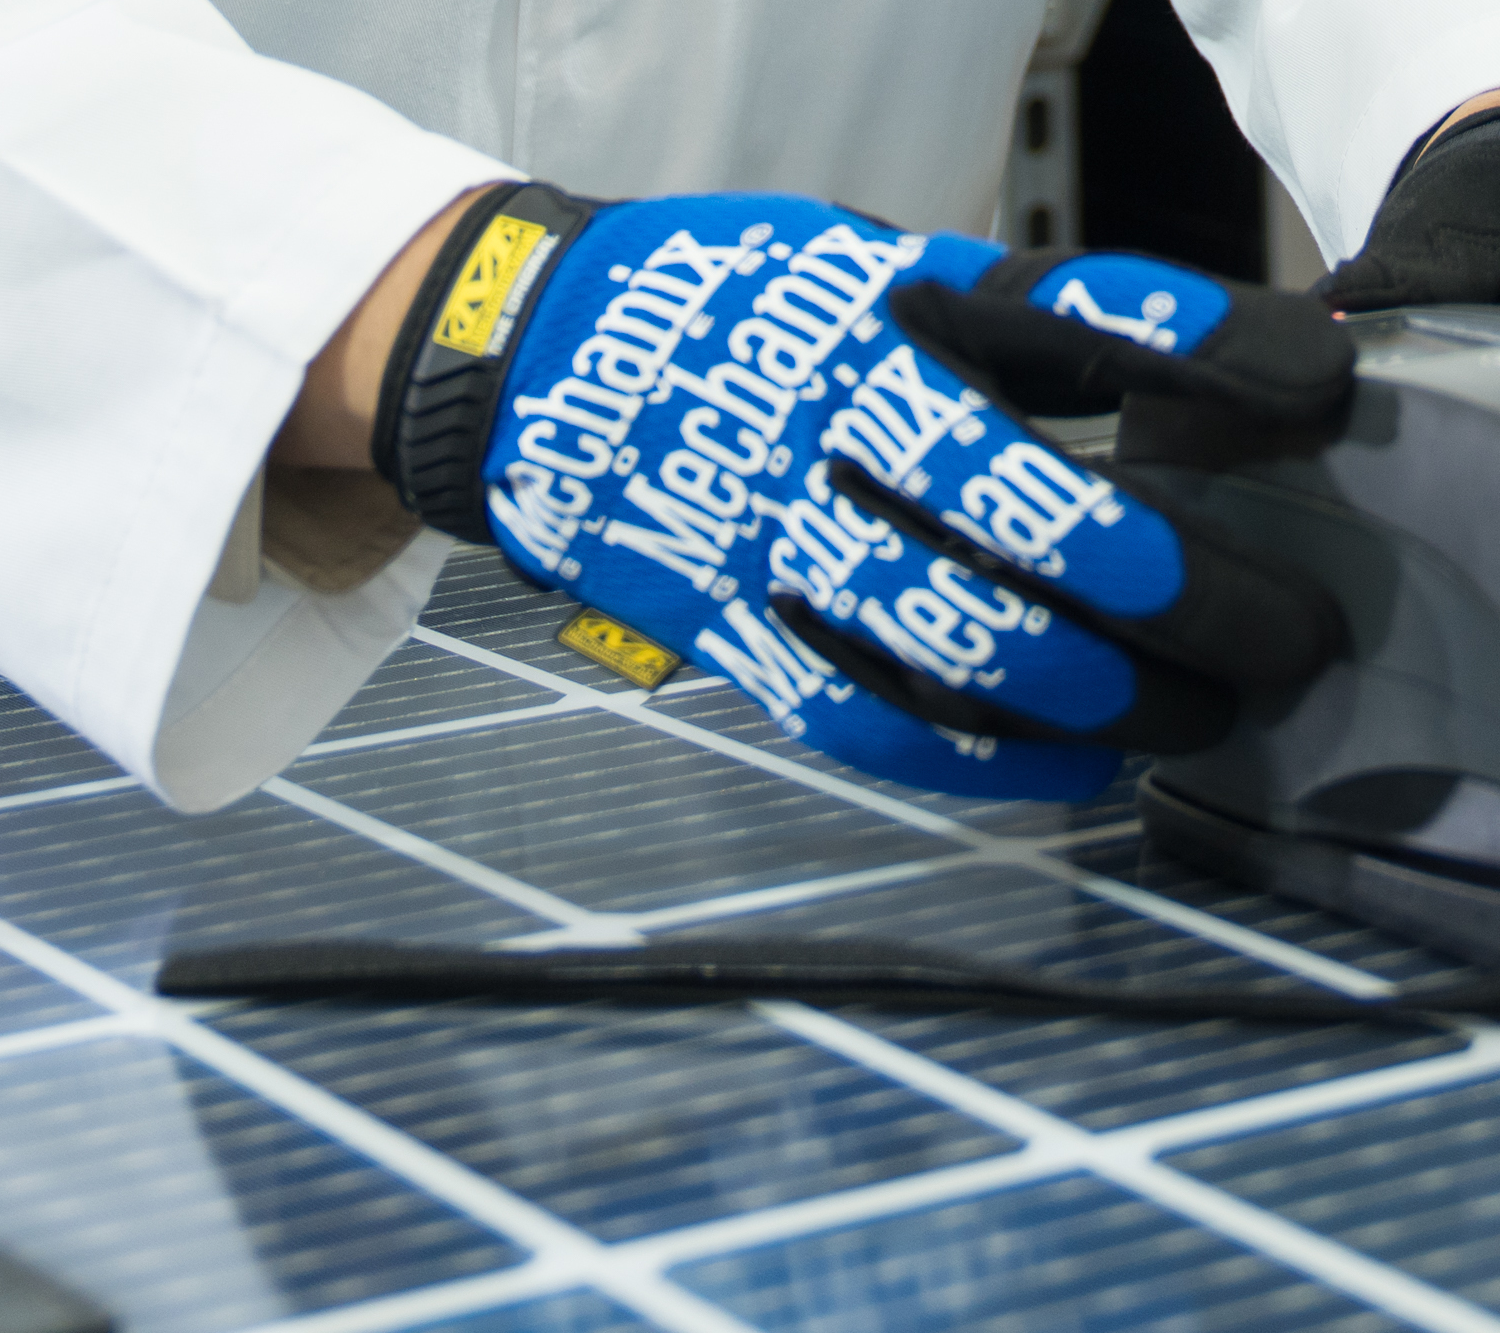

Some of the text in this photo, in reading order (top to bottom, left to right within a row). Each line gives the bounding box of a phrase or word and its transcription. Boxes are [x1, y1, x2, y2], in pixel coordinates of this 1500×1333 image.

[485, 314, 516, 357] THE
[488, 230, 748, 571] Mechanix
[602, 223, 915, 593] Mechanix
